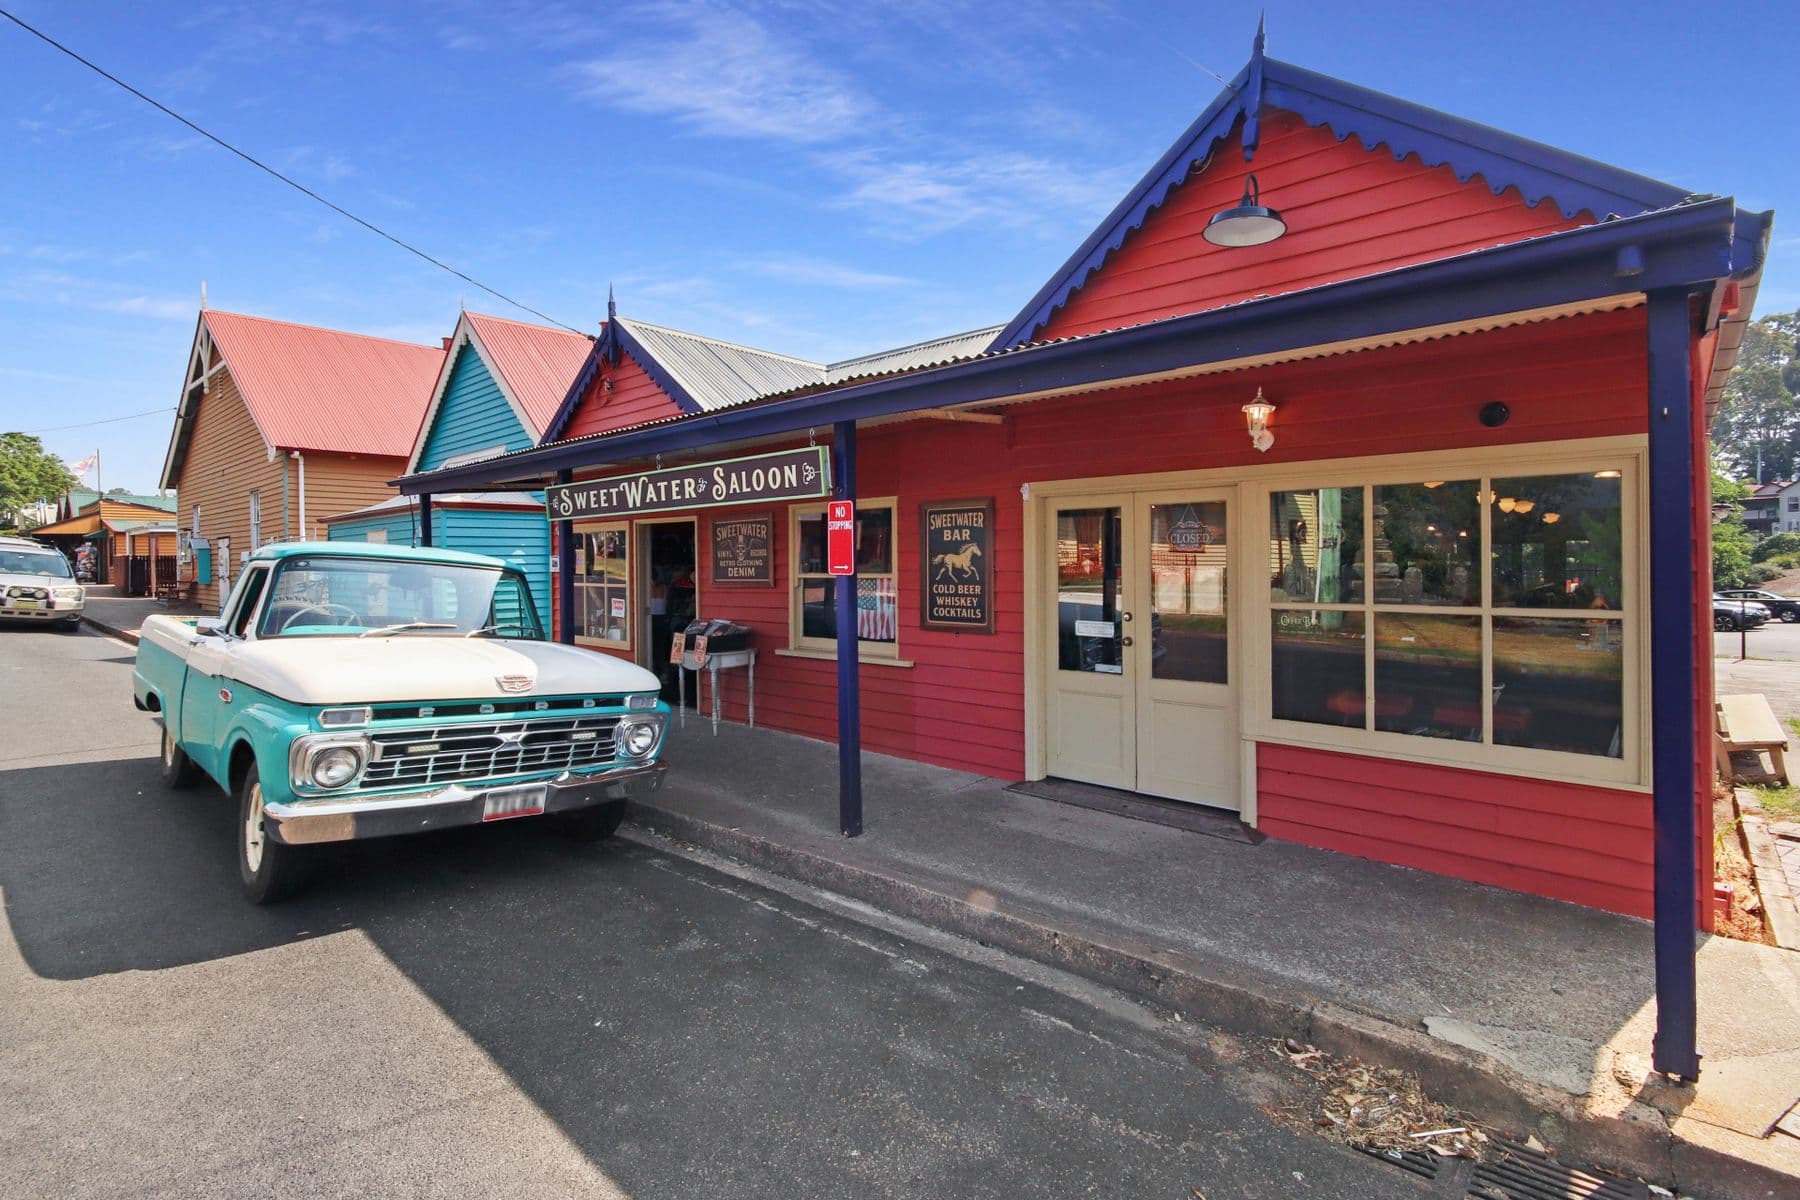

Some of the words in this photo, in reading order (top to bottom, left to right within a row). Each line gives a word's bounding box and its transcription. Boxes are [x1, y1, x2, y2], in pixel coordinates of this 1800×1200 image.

[712, 465, 797, 500] SALOON
[835, 506, 846, 518] NO
[930, 512, 984, 530] SWEETWATER
[716, 524, 766, 541] SWEETWATER
[943, 529, 970, 541] BAR
[1170, 533, 1210, 544] CLOSED
[728, 567, 755, 576] DENIM
[933, 584, 955, 594] COLD
[958, 585, 981, 595] BEER
[936, 596, 978, 607] WHISKEY
[933, 607, 981, 618] COCKTAILS
